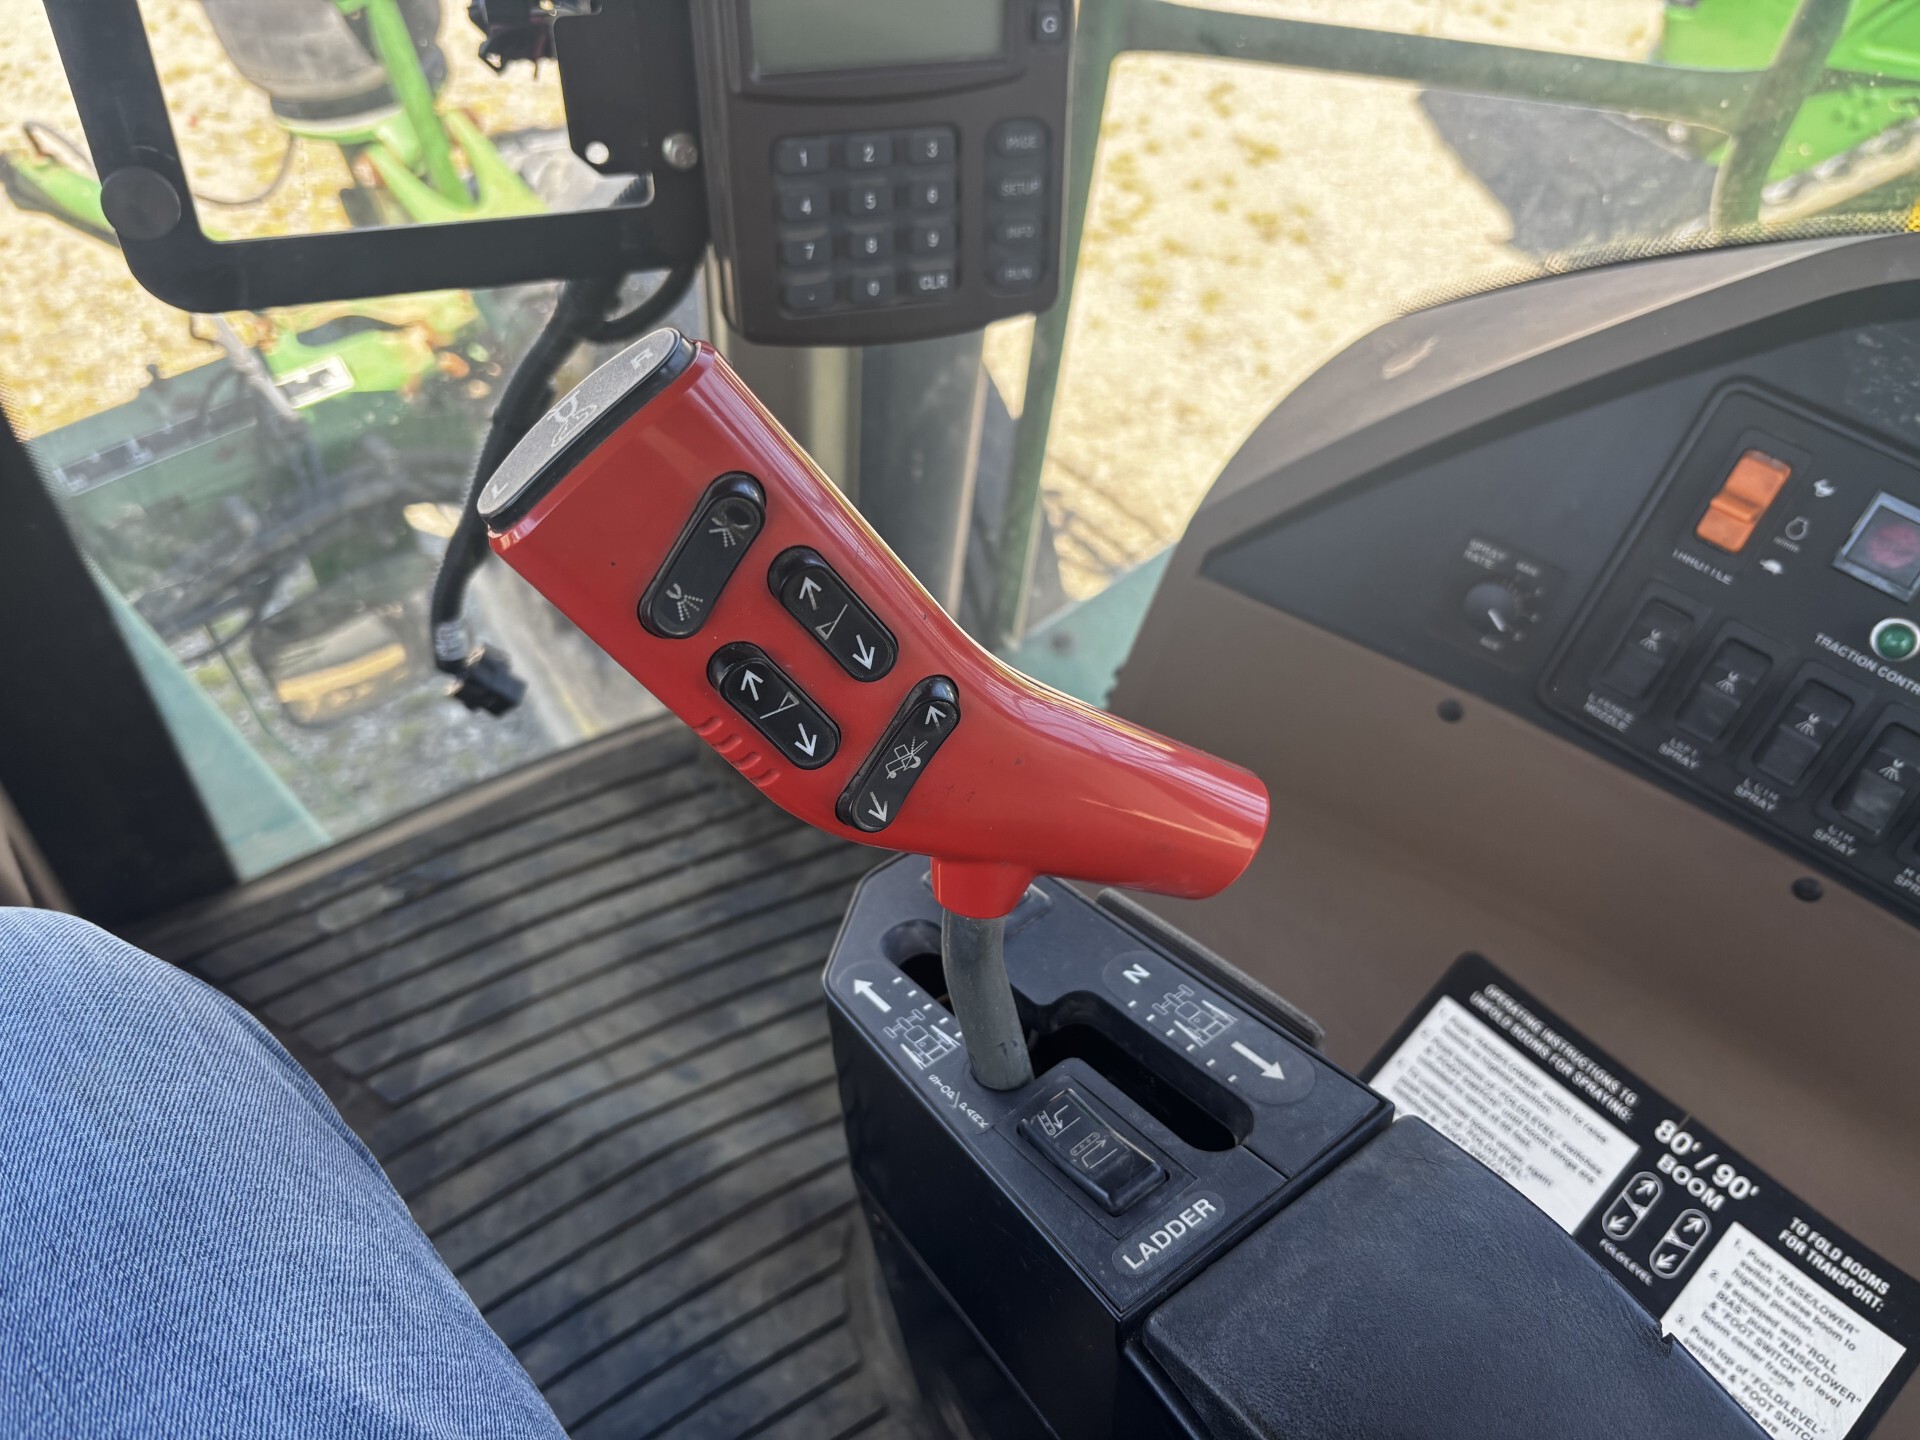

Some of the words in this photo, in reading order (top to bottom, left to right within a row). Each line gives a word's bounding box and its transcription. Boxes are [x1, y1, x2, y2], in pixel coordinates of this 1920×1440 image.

[800, 148, 808, 167] 1
[863, 143, 875, 162] 2
[926, 139, 938, 158] 3
[801, 196, 812, 215] 4
[864, 191, 877, 210] 5
[926, 185, 939, 204] 6
[1001, 176, 1042, 196] SETUP
[804, 242, 815, 260] 7
[865, 236, 878, 254] 8
[927, 230, 939, 248] 9
[918, 272, 949, 291] CLR
[1672, 549, 1735, 586] THROTTLE
[1815, 632, 1878, 672] TRACTION
[1658, 742, 1700, 771] SPRAY
[1733, 784, 1778, 813] SPRAY
[1813, 828, 1857, 857] SPRAY
[1122, 963, 1151, 985] N
[1469, 991, 1514, 1029] UNFOLD
[1509, 1022, 1553, 1060] BOOMS
[1548, 1053, 1575, 1077] FOR
[1483, 983, 1545, 1034] OPERATING
[1540, 1028, 1621, 1093] INSTRUCTIONS
[1617, 1087, 1638, 1107] TO
[1541, 1089, 1573, 1115] switch
[1547, 1146, 1578, 1172] wings
[1577, 1168, 1595, 1184] are
[1656, 1152, 1726, 1212] BOOM
[1121, 1196, 1218, 1271] LADDER
[1788, 1216, 1810, 1236] TO
[1807, 1231, 1842, 1261] FOLD
[1840, 1255, 1890, 1295] BOOMS
[1746, 1248, 1774, 1272] Push
[1774, 1269, 1859, 1337] "RAISE/LOWER"
[1778, 1229, 1806, 1254] FOR
[1805, 1248, 1885, 1312] TRANSPORT:
[1722, 1280, 1732, 1290] If
[1729, 1288, 1780, 1329] equipped
[1779, 1325, 1803, 1346] with
[1802, 1343, 1839, 1374] "ROLL
[1730, 1268, 1770, 1301] highest
[1769, 1299, 1815, 1337] position.
[1739, 1259, 1773, 1287] switch
[1773, 1285, 1785, 1297] to
[1785, 1294, 1813, 1318] raise
[1812, 1315, 1844, 1341] boom
[1843, 1339, 1856, 1351] to
[1682, 1337, 1727, 1375] switches
[1726, 1373, 1736, 1383] &
[1737, 1381, 1773, 1412] "FOOT
[1699, 1311, 1731, 1337] boom
[1730, 1334, 1764, 1363] center
[1763, 1361, 1798, 1390] frame.
[1717, 1308, 1754, 1339] "FOOT
[1753, 1337, 1803, 1377] SWITCH"
[1801, 1374, 1815, 1387] to
[1814, 1385, 1841, 1408] level
[1746, 1315, 1774, 1340] push
[1773, 1336, 1860, 1405] "RAISE/LOWER"
[1688, 1326, 1717, 1351] Push
[1715, 1348, 1737, 1368] top
[1735, 1363, 1748, 1375] of
[1747, 1372, 1824, 1437] "FOLD/LEVEL"
[1760, 1417, 1779, 1434] are
